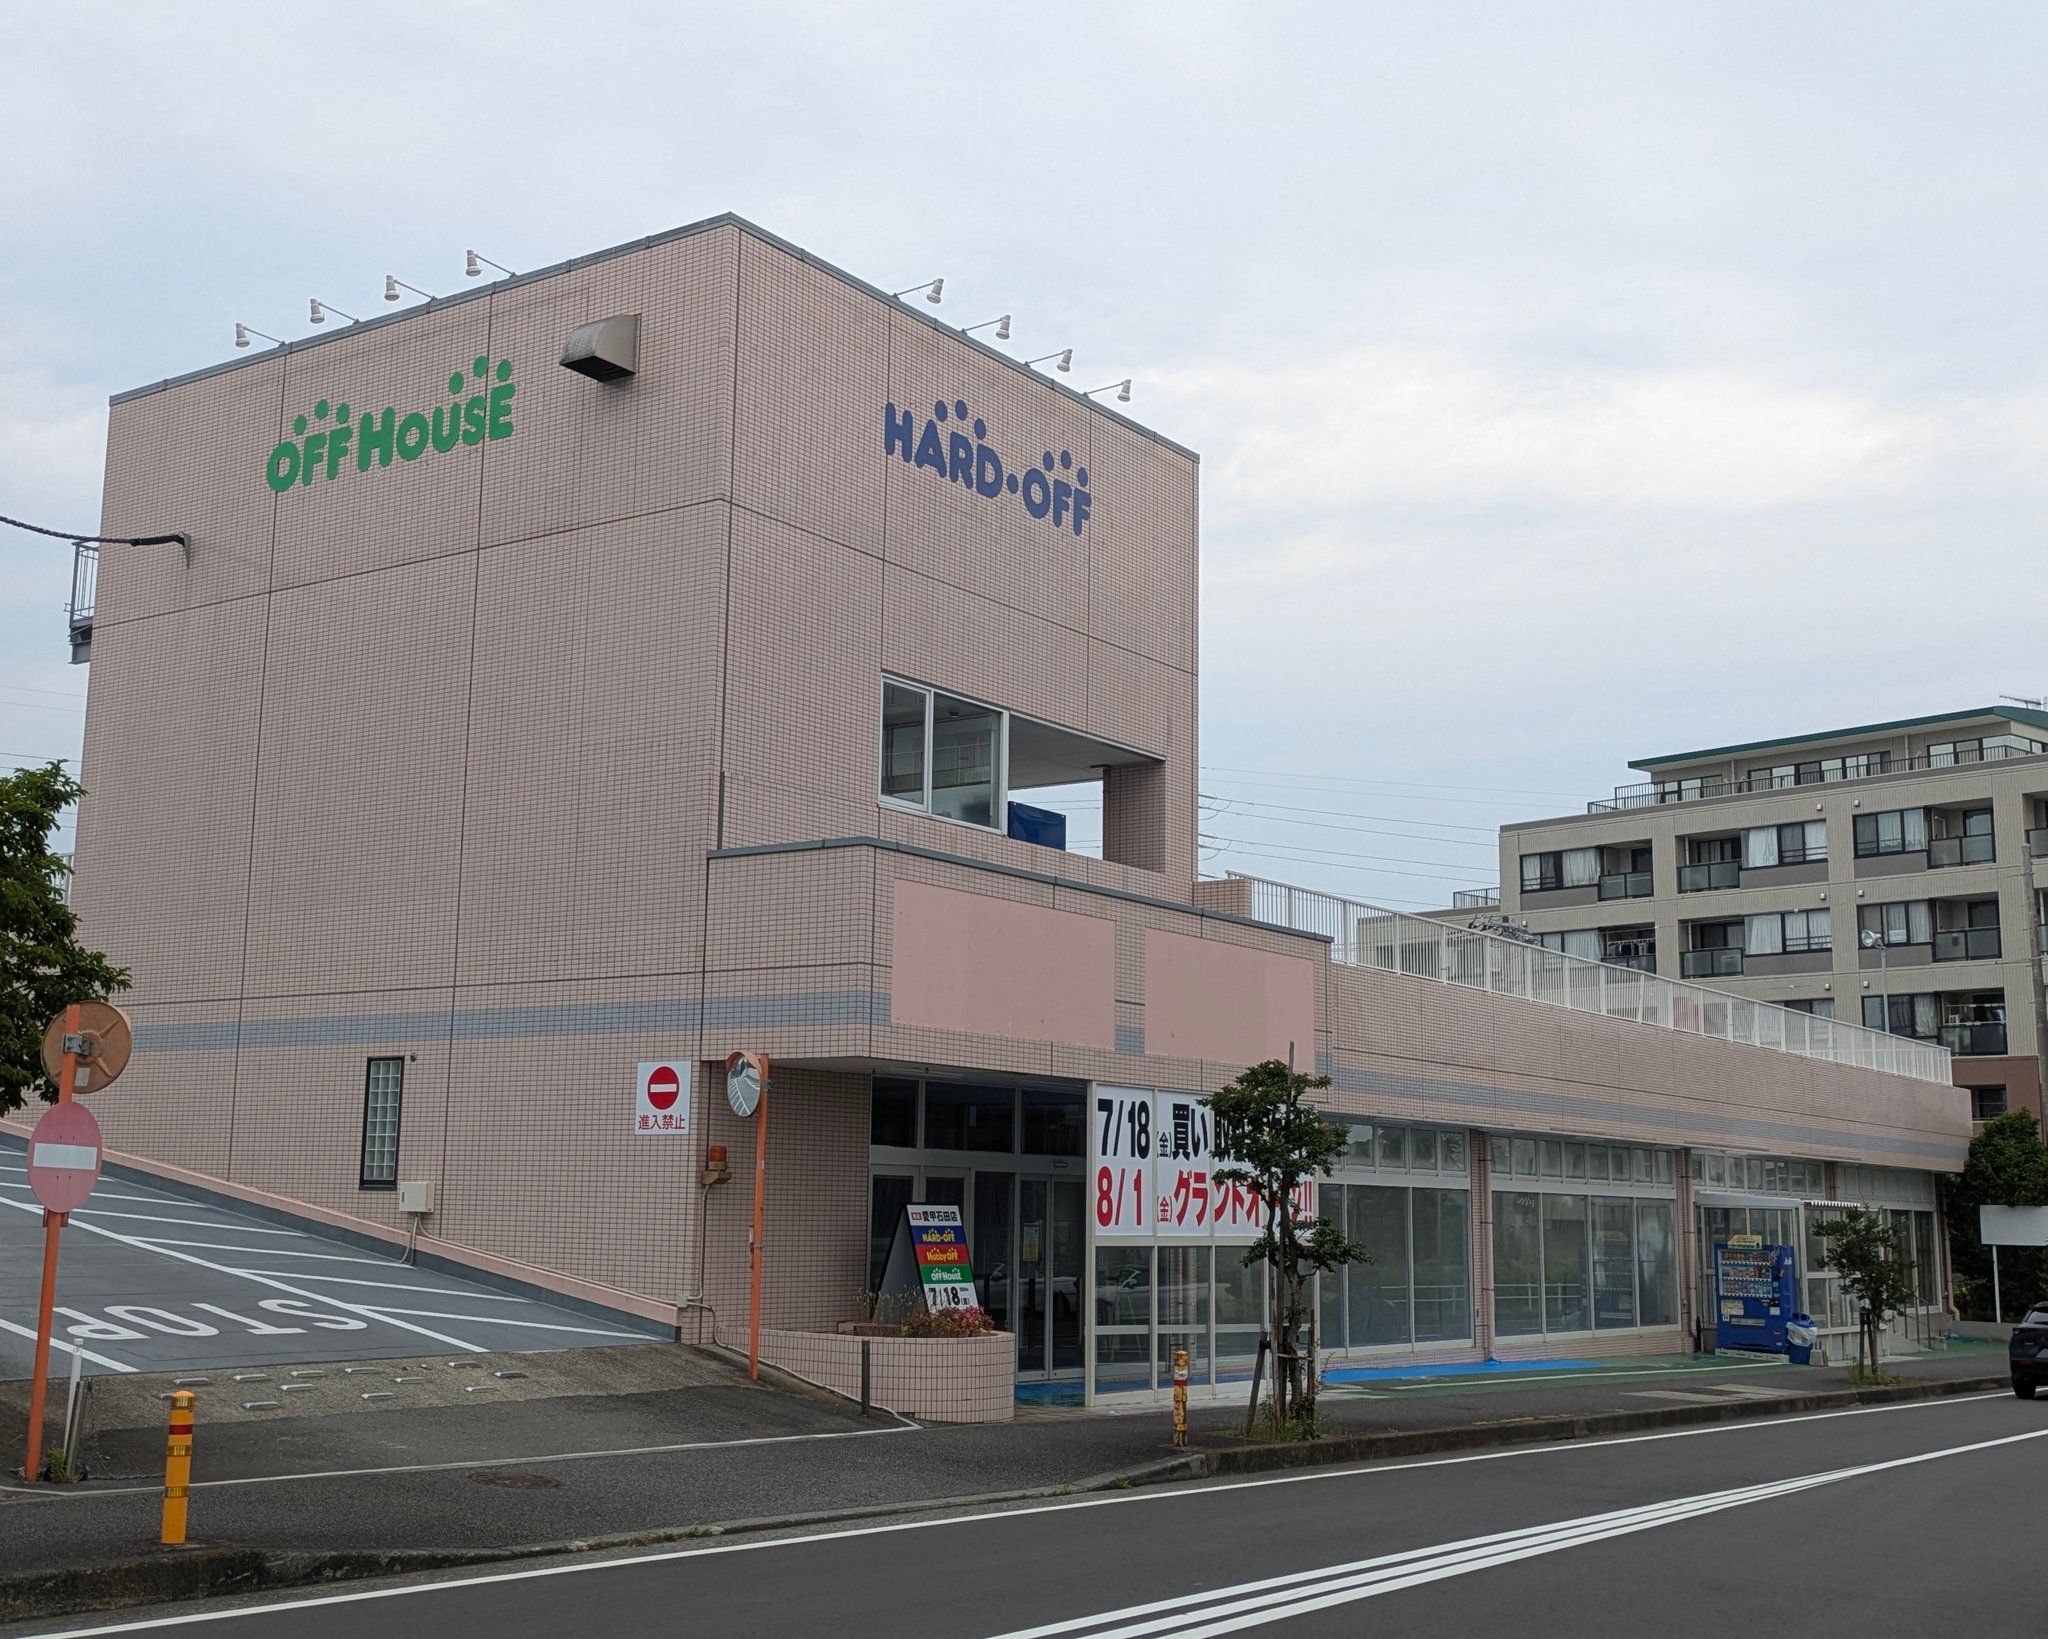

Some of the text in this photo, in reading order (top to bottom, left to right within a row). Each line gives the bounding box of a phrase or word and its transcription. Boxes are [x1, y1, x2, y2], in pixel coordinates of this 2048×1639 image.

[638, 1114, 686, 1130] 進入禁止
[922, 1210, 958, 1222] 愛甲石田店
[52, 1299, 368, 1340] STOP
